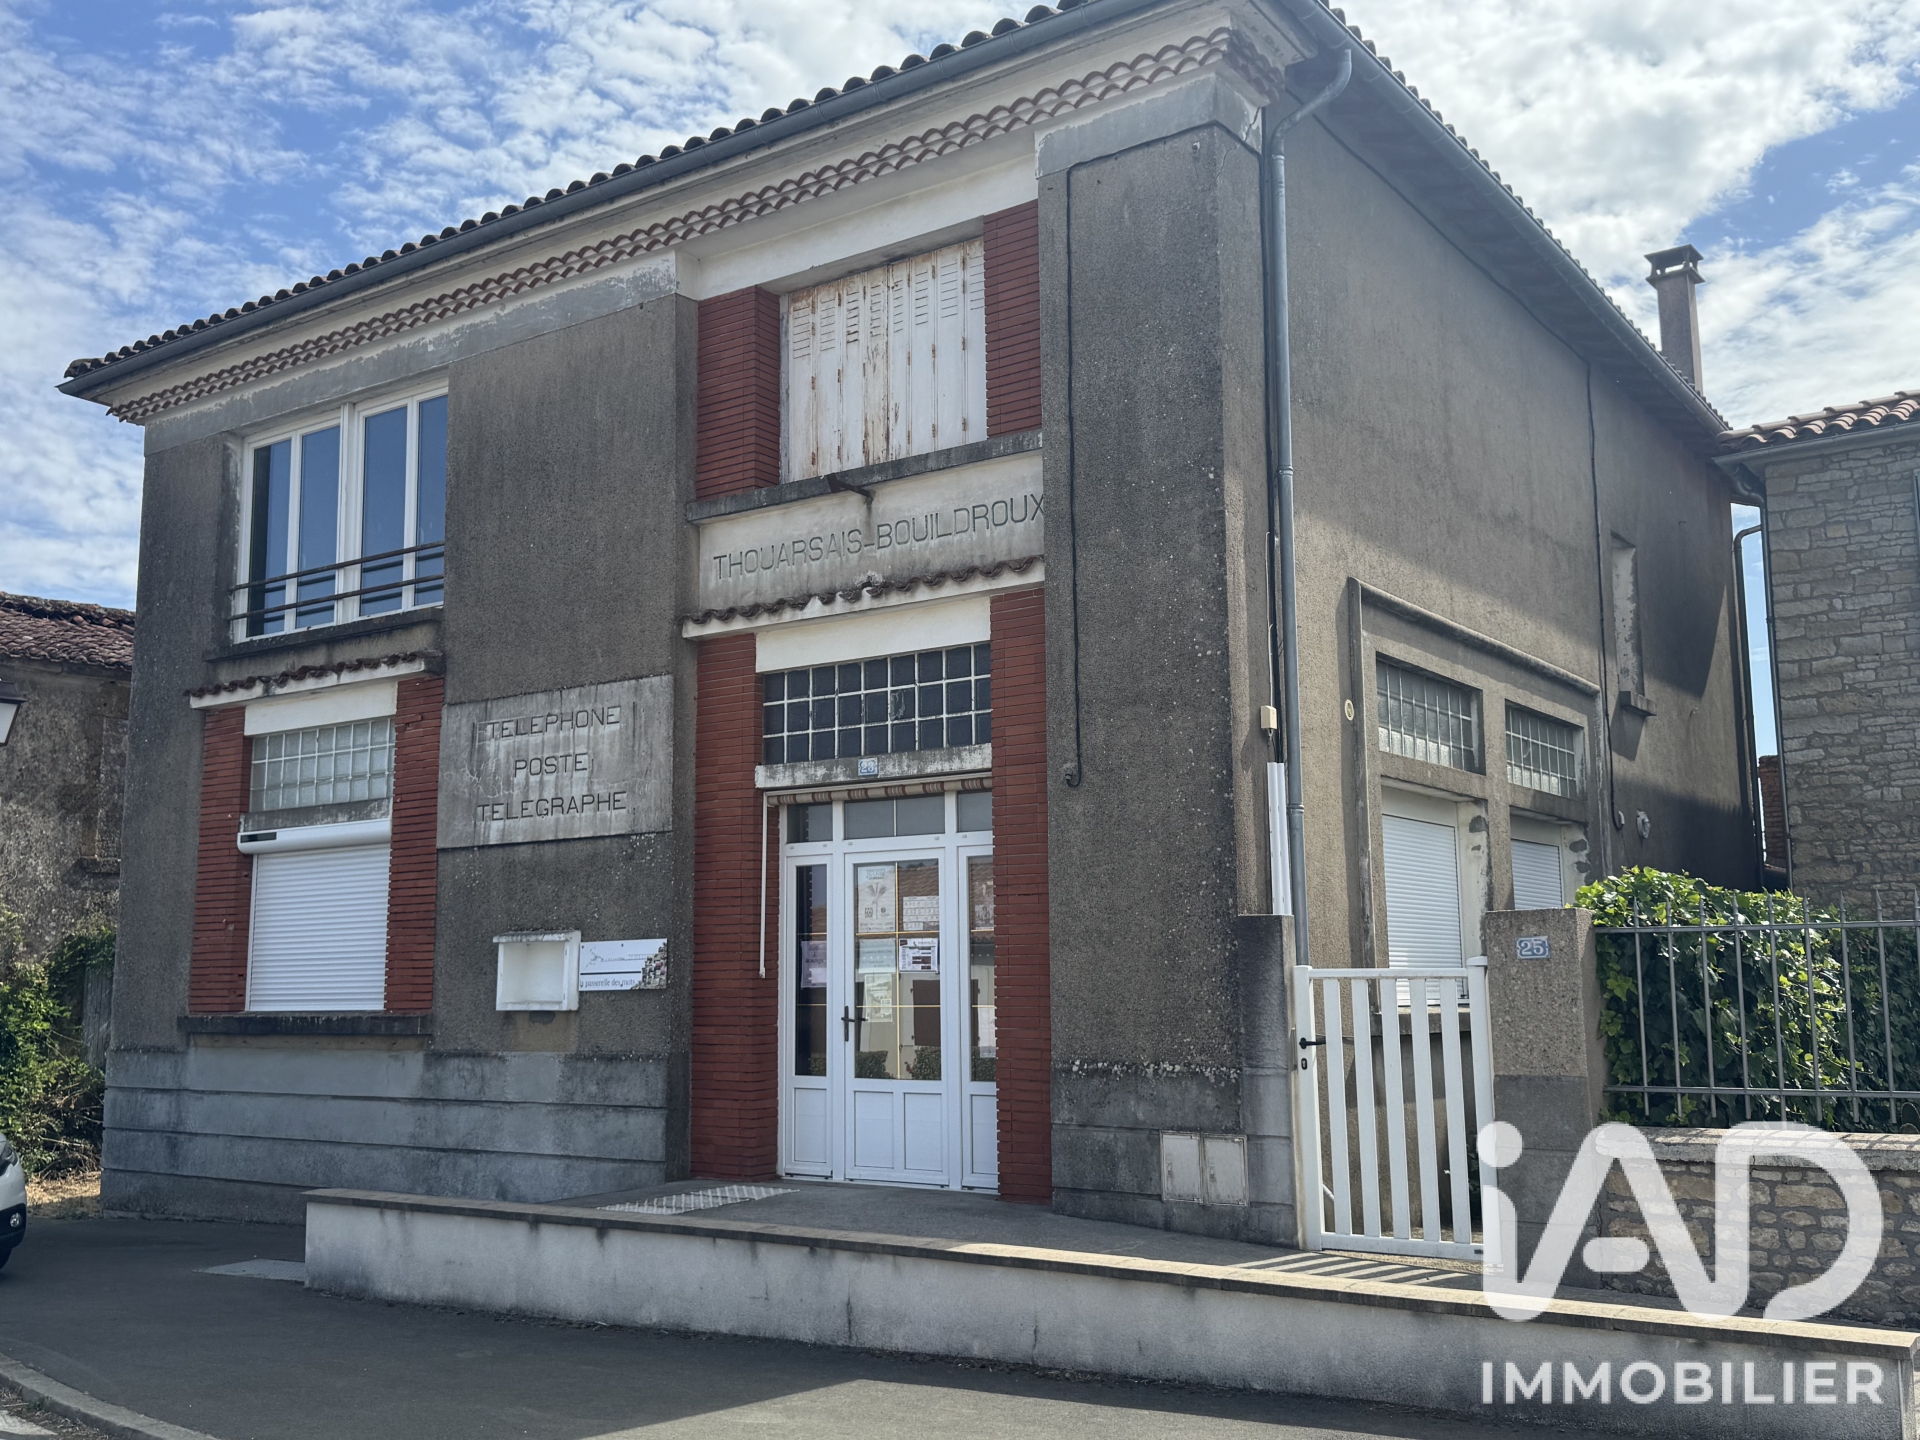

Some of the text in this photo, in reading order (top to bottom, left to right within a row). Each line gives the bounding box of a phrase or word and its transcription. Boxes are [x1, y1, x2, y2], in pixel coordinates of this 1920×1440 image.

[713, 493, 1044, 580] THOUARSAIS-BOUILDROUX
[487, 705, 622, 739] TELEPHONE
[514, 752, 588, 778] POSTE
[476, 791, 627, 822] TELEGRAPHE
[1520, 940, 1544, 956] 25
[585, 979, 611, 988] passerelle
[611, 978, 620, 986] des
[621, 979, 636, 987] mots
